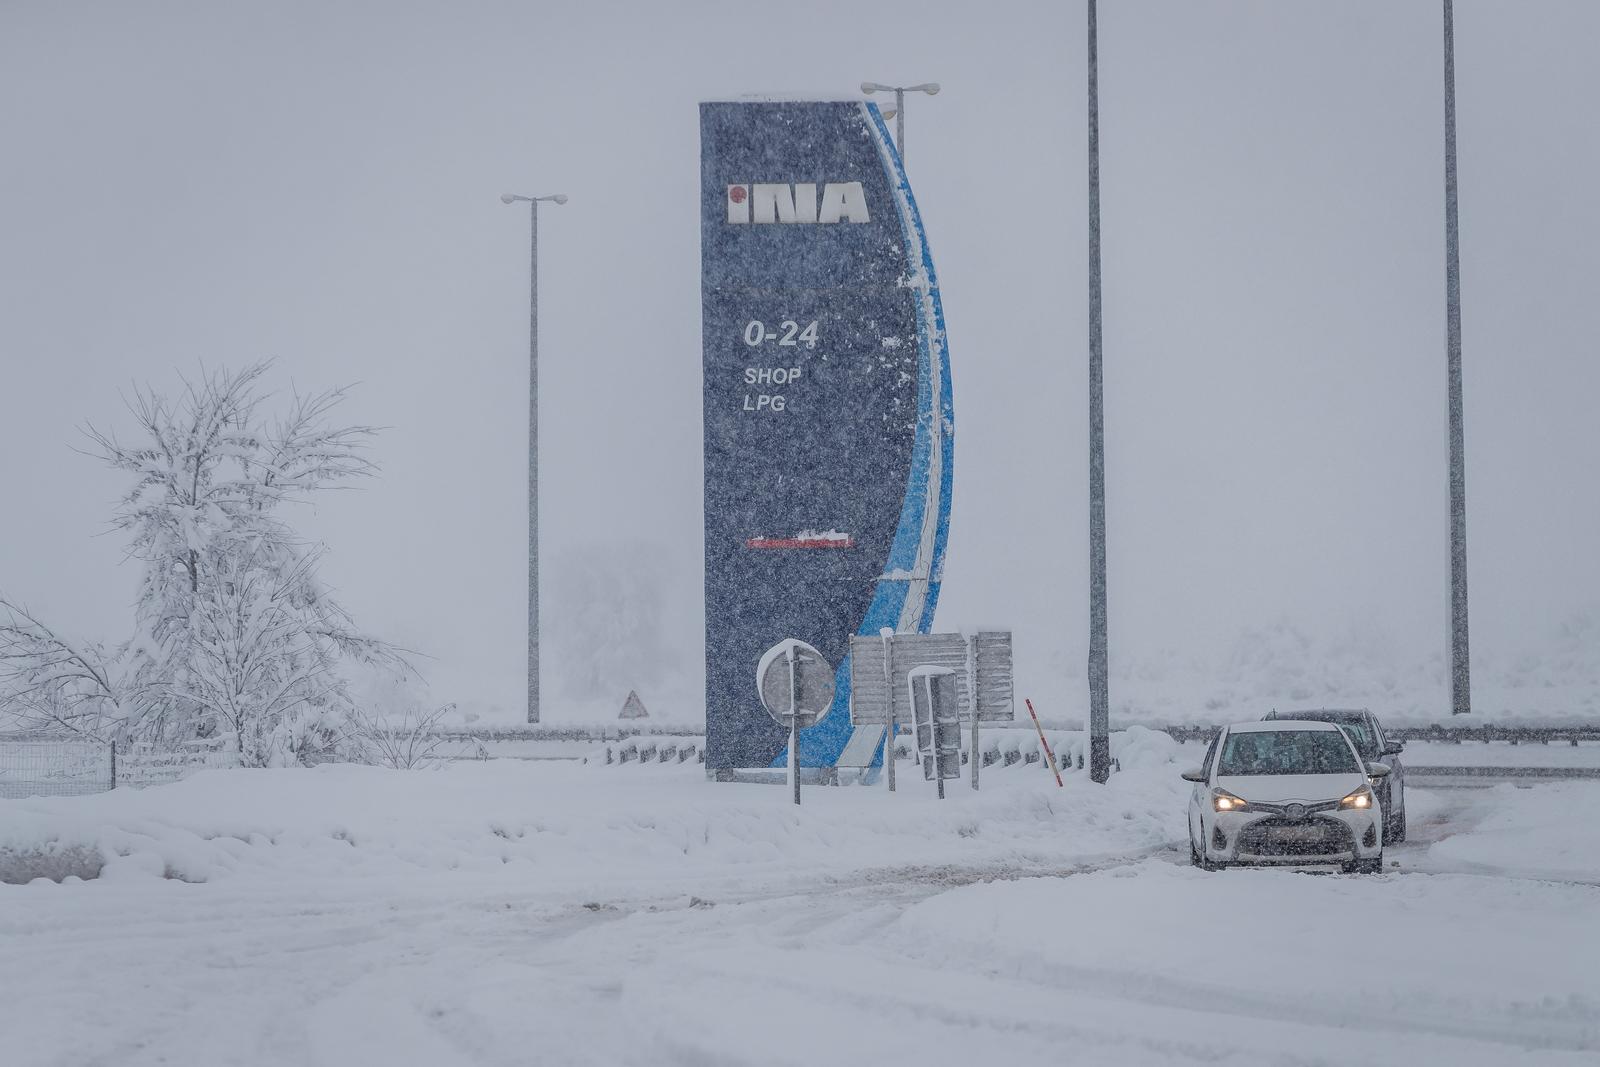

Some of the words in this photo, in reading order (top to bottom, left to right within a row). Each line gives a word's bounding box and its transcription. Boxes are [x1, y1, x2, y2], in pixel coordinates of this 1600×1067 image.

[744, 320, 819, 348] 0-24
[744, 367, 802, 384] SHOP
[743, 394, 786, 412] LPG
